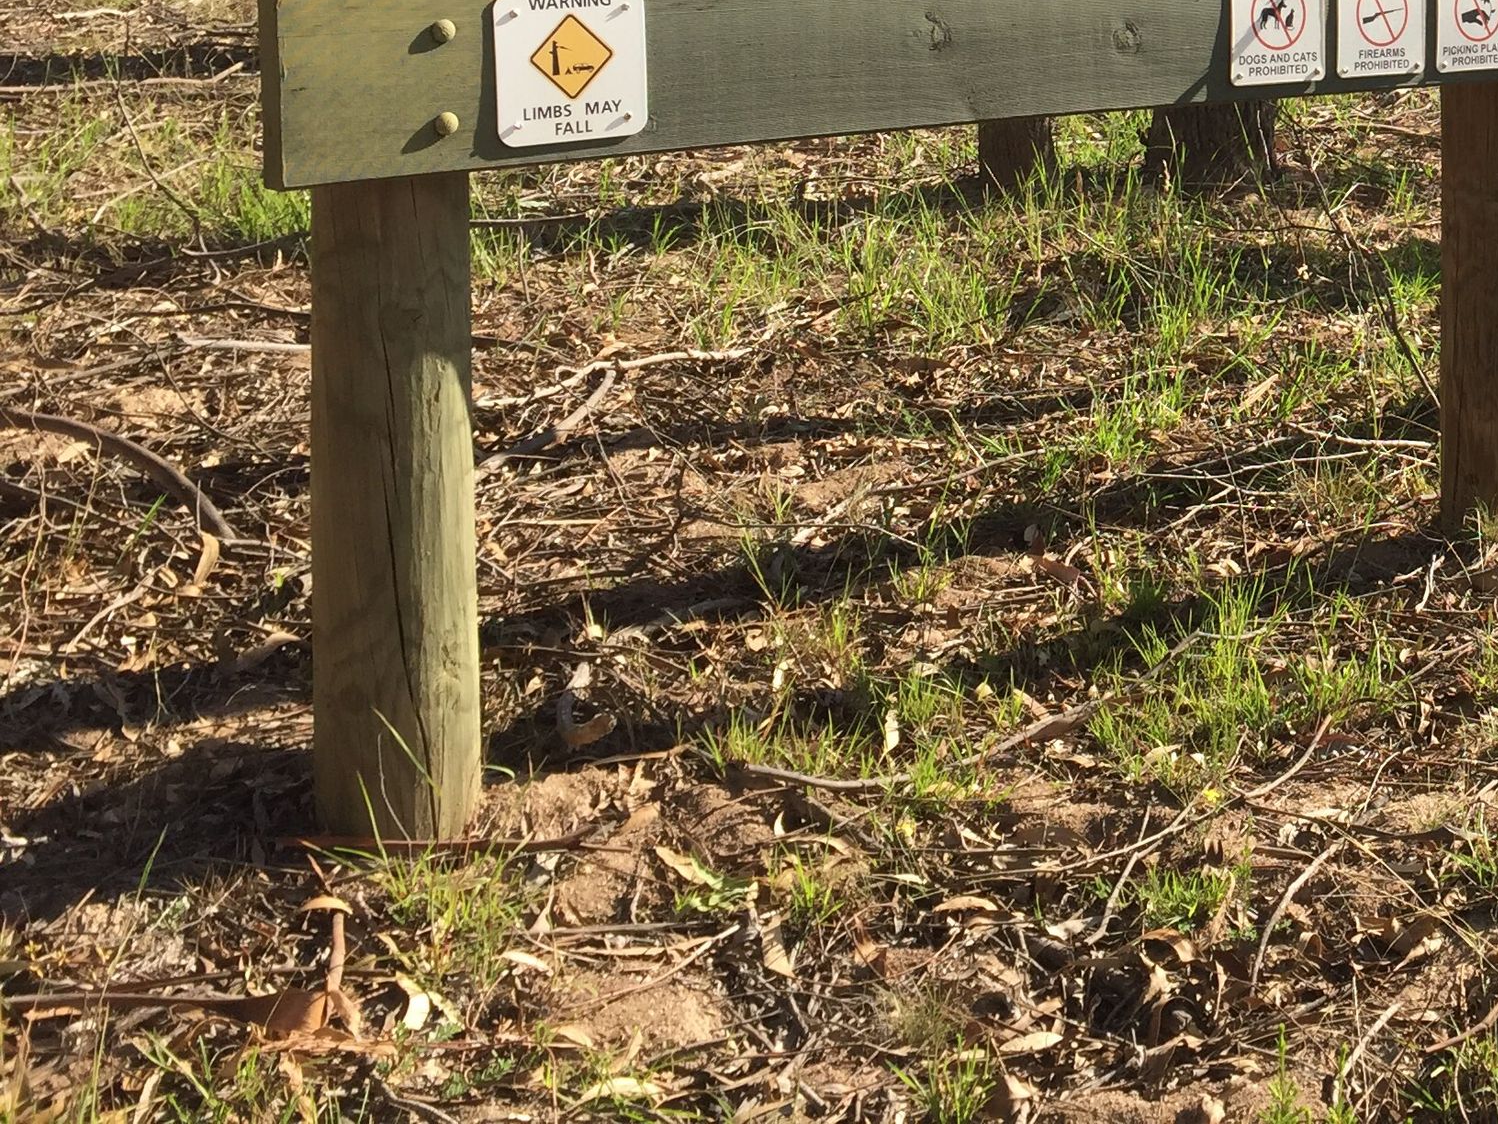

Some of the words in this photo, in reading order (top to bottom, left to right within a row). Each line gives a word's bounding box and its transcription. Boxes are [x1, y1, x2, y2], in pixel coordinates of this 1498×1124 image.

[1359, 48, 1406, 59] FIREARMS
[1442, 44, 1479, 56] PICKING
[1239, 53, 1268, 65] DOGS
[1269, 52, 1291, 64] AND
[1292, 51, 1318, 63] CATS
[1248, 63, 1309, 76] PROHIBITED
[1354, 59, 1410, 71] PROHIBITED
[523, 104, 572, 121] LIMBS
[585, 99, 622, 115] MAY
[555, 120, 593, 136] FALL
